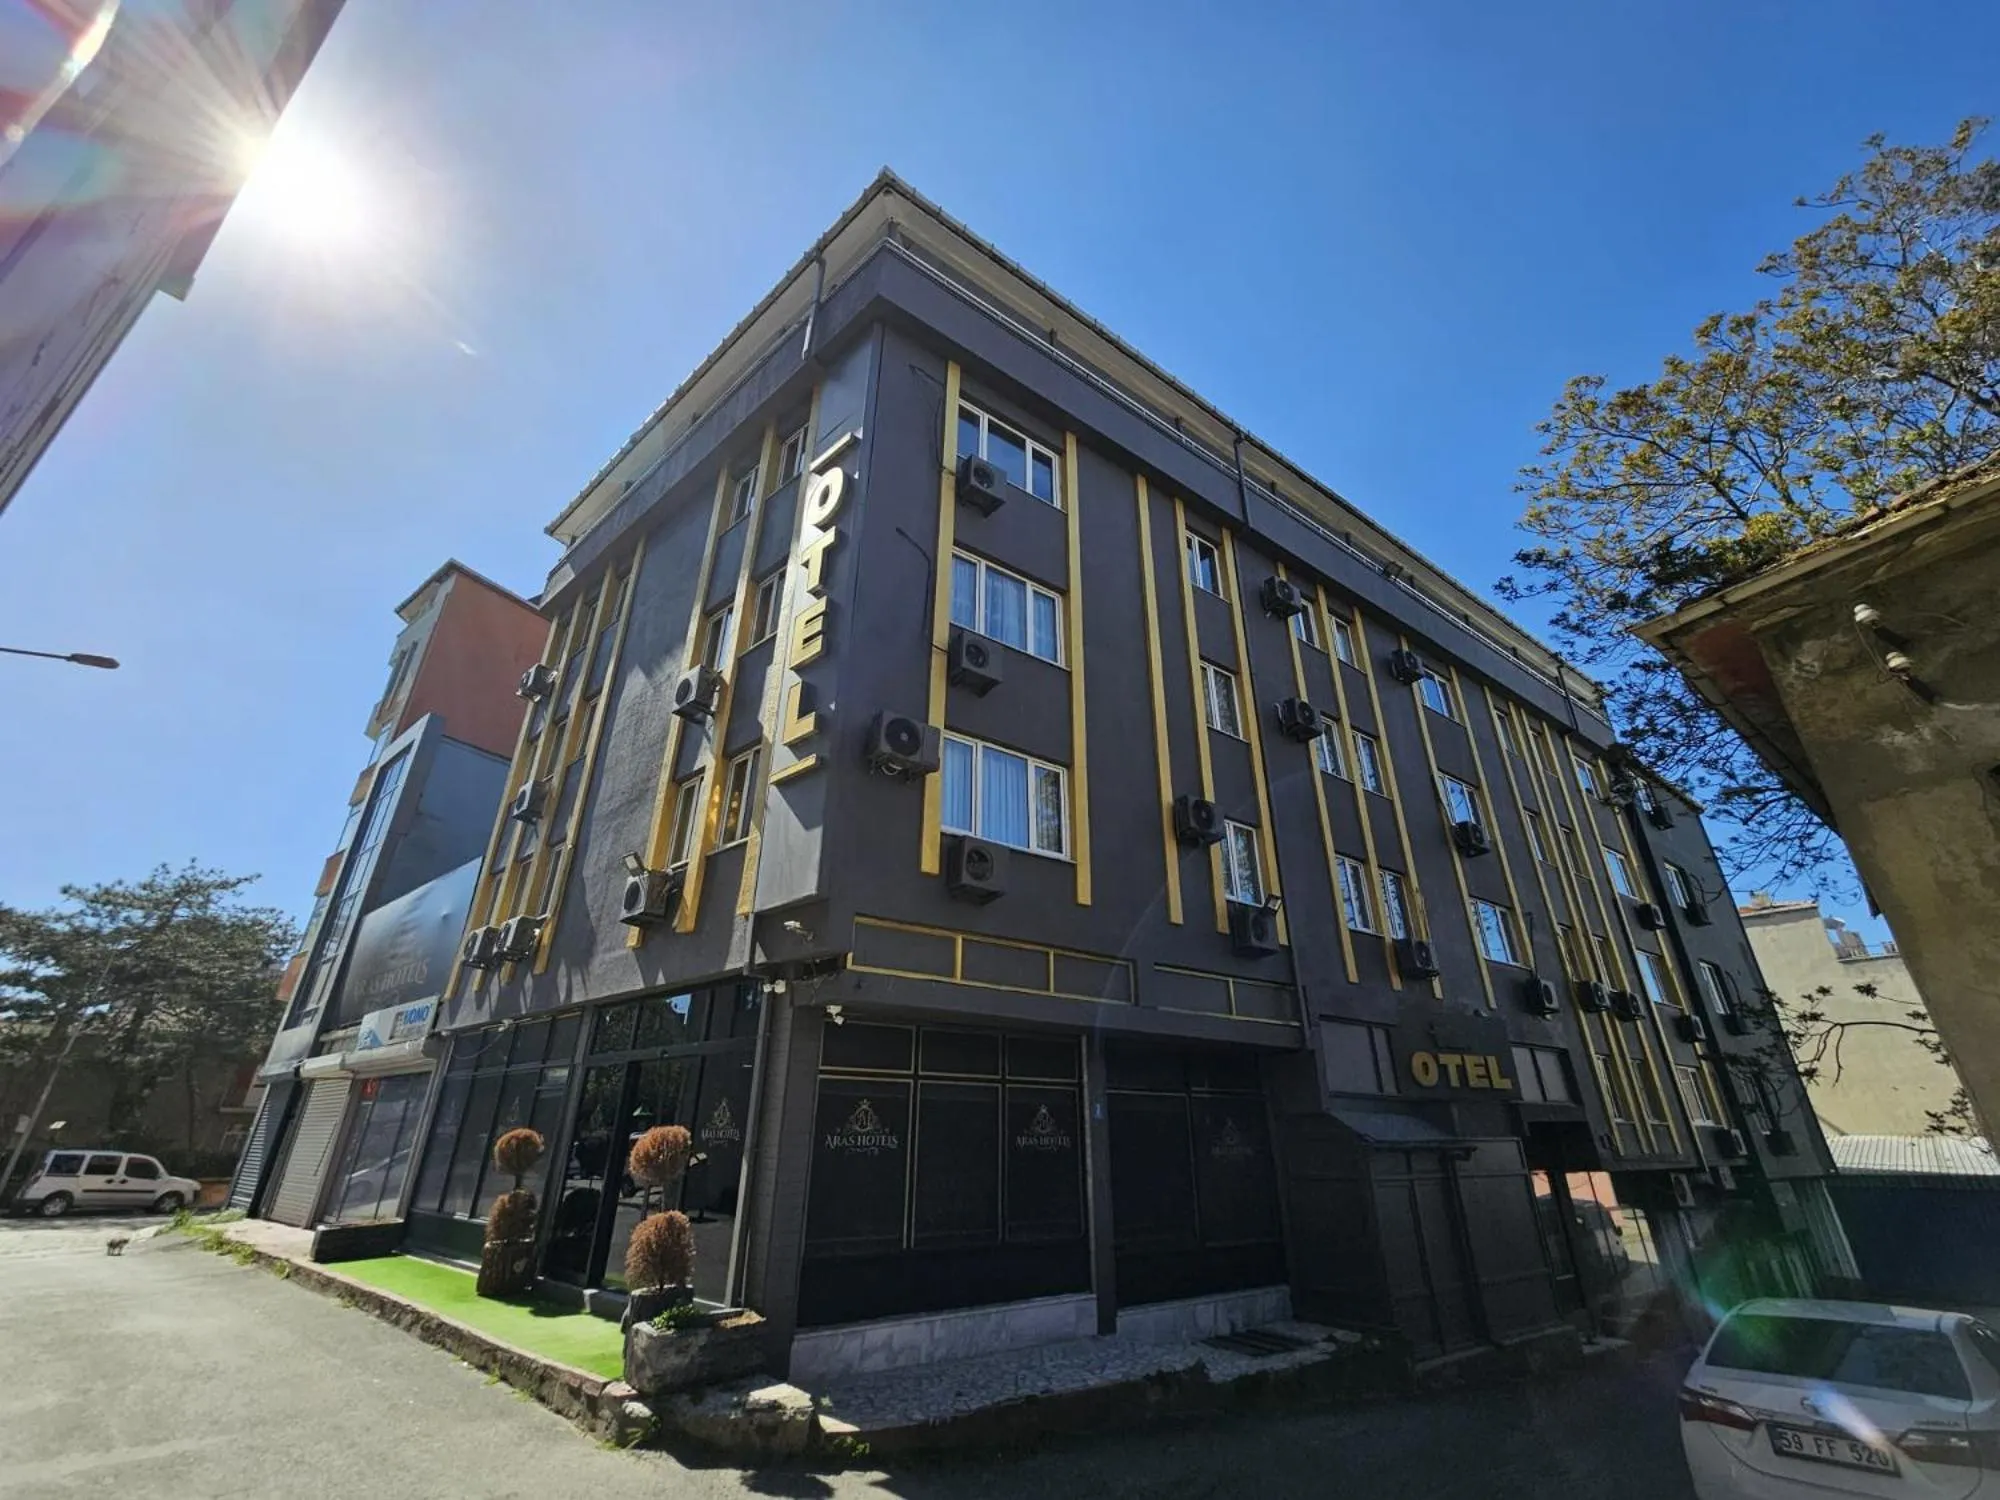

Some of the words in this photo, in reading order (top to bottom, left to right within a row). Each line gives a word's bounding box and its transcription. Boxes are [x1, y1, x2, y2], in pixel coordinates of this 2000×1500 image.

[782, 465, 846, 746] OTEL
[1411, 1051, 1513, 1090] OTEL
[824, 1134, 855, 1150] ARAS
[856, 1134, 899, 1149] HOTELS
[1812, 1436, 1838, 1457] FF
